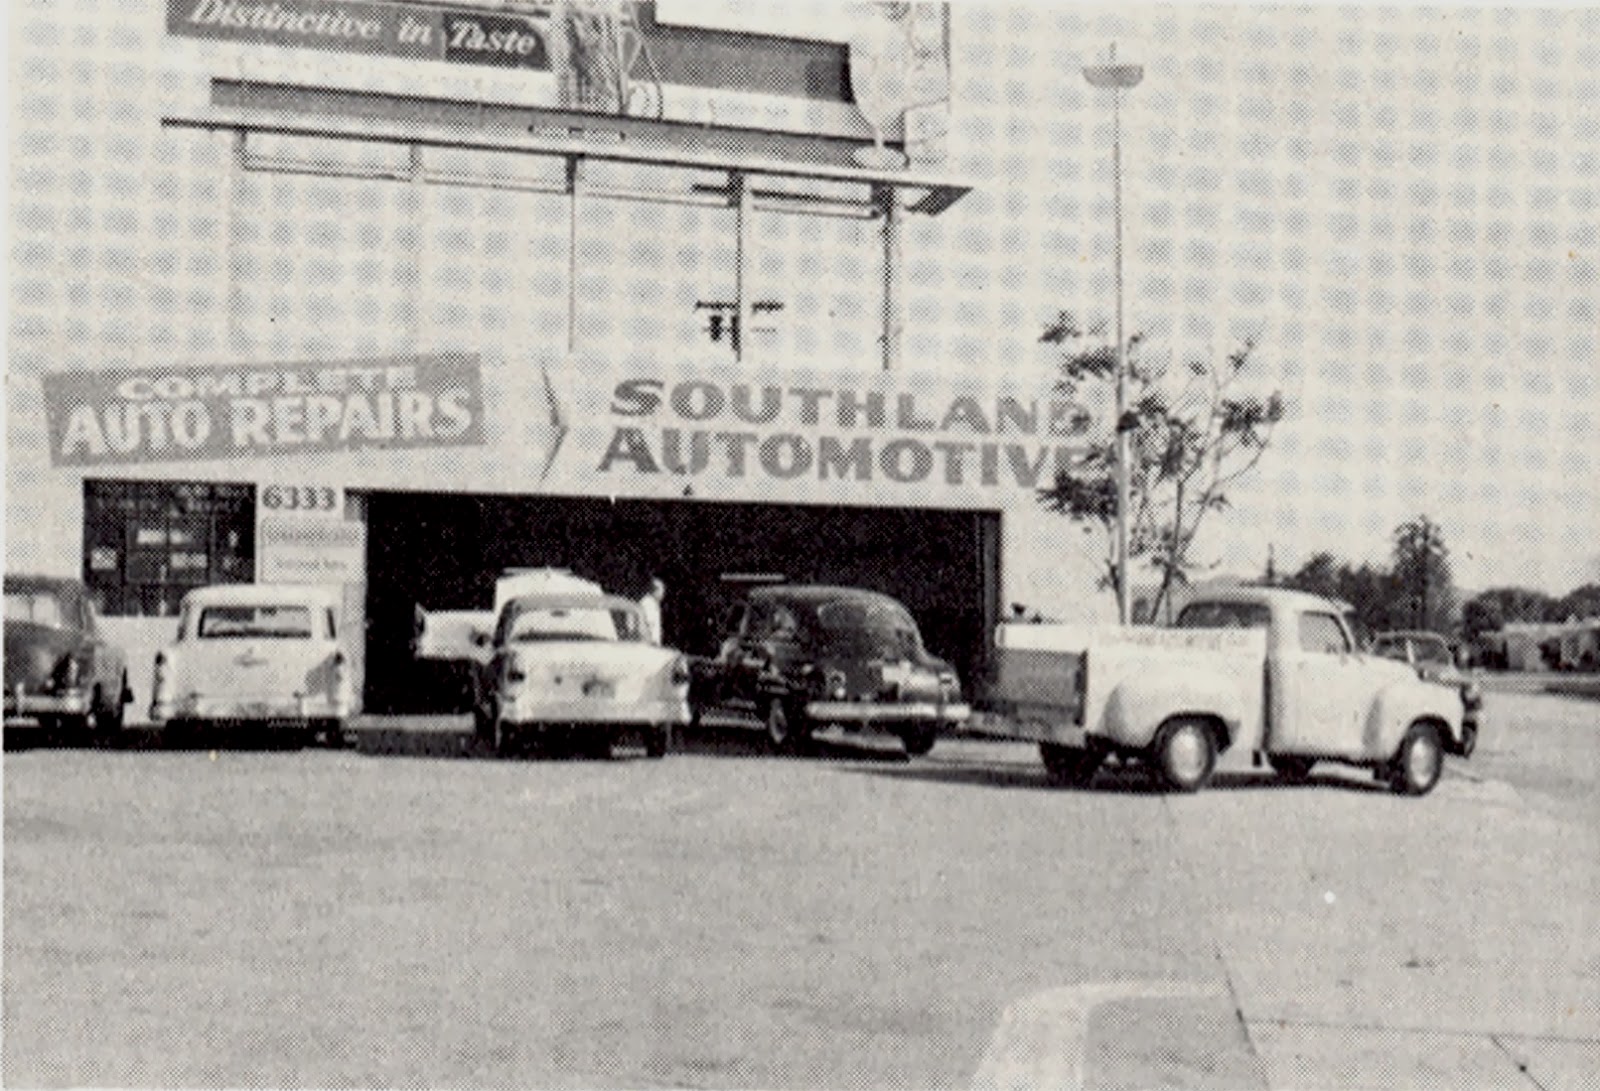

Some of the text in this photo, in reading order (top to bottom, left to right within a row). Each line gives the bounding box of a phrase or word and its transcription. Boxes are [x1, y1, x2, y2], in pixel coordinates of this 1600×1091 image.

[187, 0, 535, 54] Distinctive in Taste
[118, 367, 416, 400] COMPLETE
[610, 378, 1092, 437] SOUTHLAND
[60, 388, 474, 458] AUTO REPAIRS
[262, 485, 336, 511] 6333
